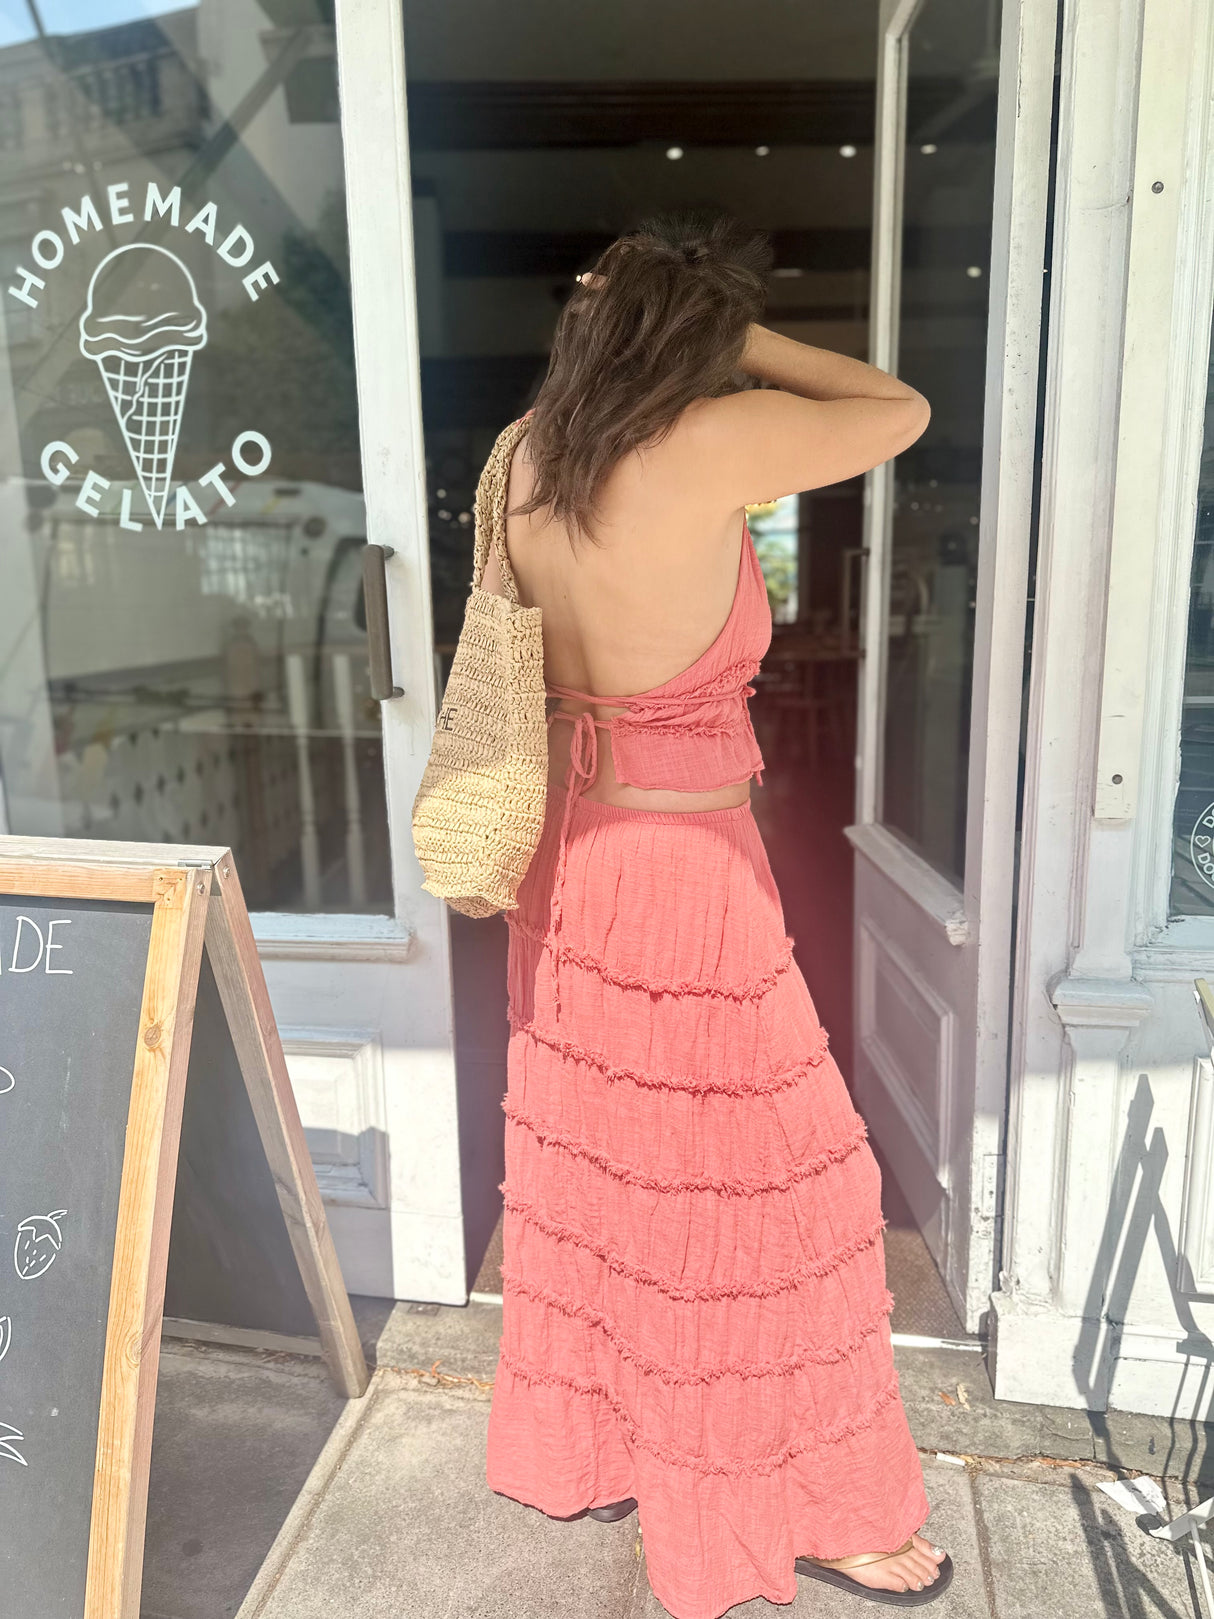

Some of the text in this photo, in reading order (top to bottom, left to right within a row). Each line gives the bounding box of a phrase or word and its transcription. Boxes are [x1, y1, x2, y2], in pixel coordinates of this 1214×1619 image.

[8, 182, 280, 309] HOMEMADE
[40, 430, 272, 532] GELATO
[0, 915, 74, 976] DE
